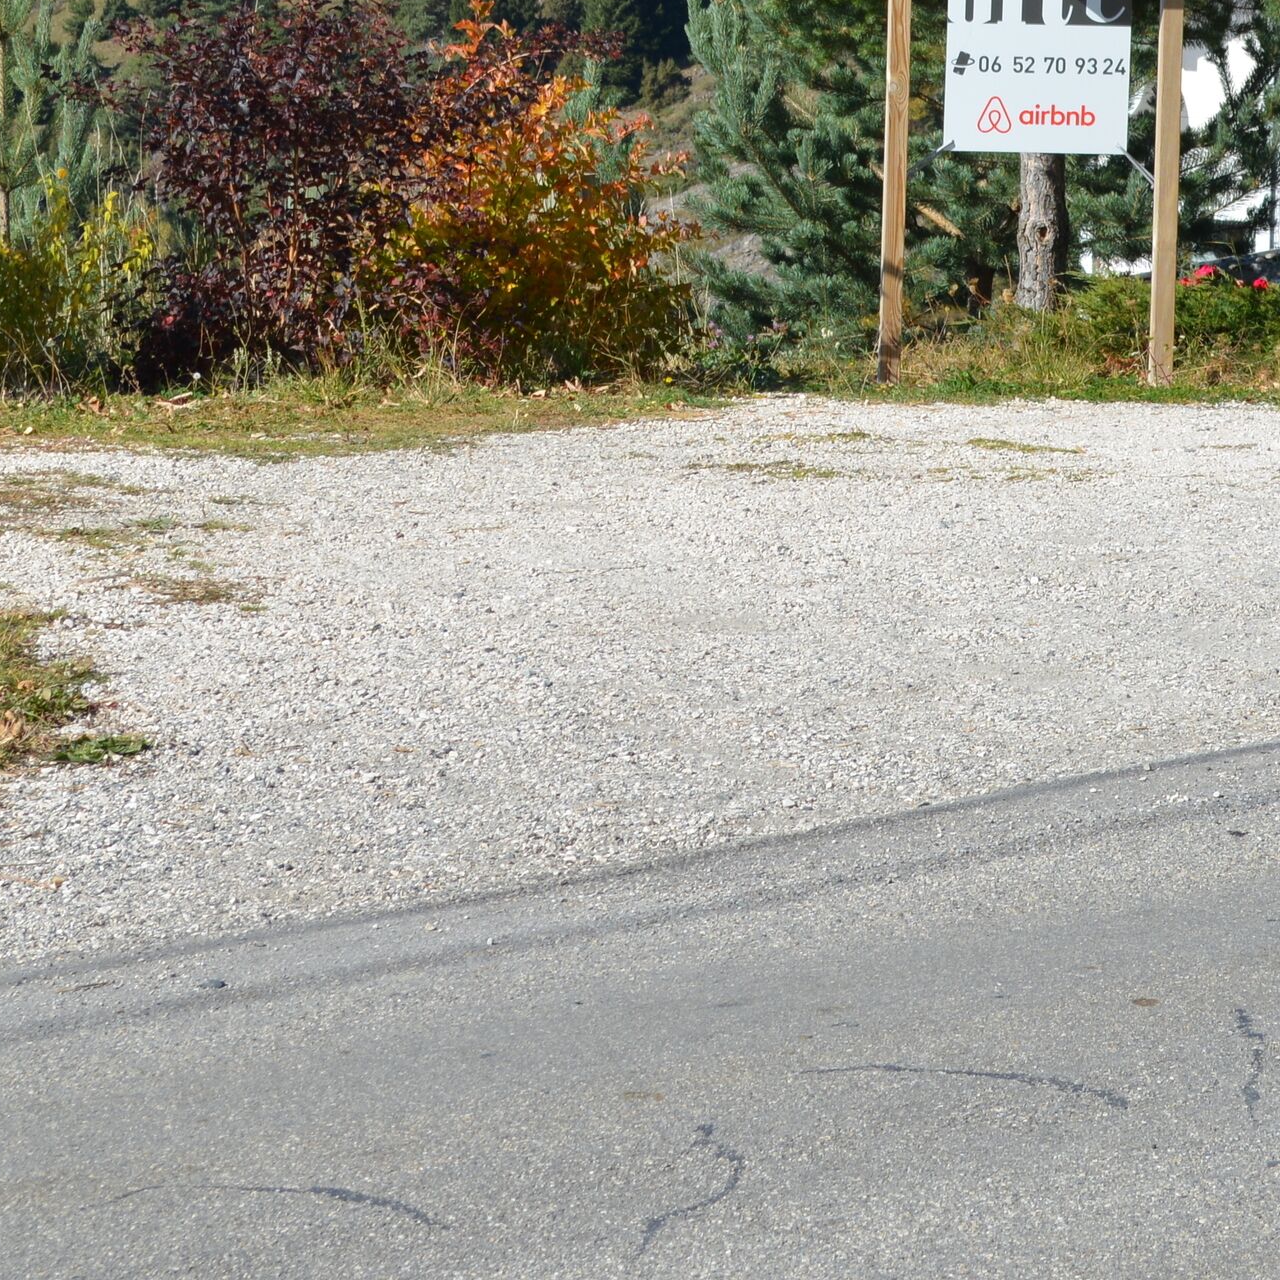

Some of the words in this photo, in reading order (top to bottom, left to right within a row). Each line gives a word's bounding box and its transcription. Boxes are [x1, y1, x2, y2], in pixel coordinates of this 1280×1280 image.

[979, 55, 1002, 73] 06
[1013, 56, 1035, 73] 52
[1044, 57, 1066, 74] 70
[1075, 58, 1098, 75] 93
[1103, 58, 1126, 75] 24
[1019, 104, 1096, 127] airbnb
